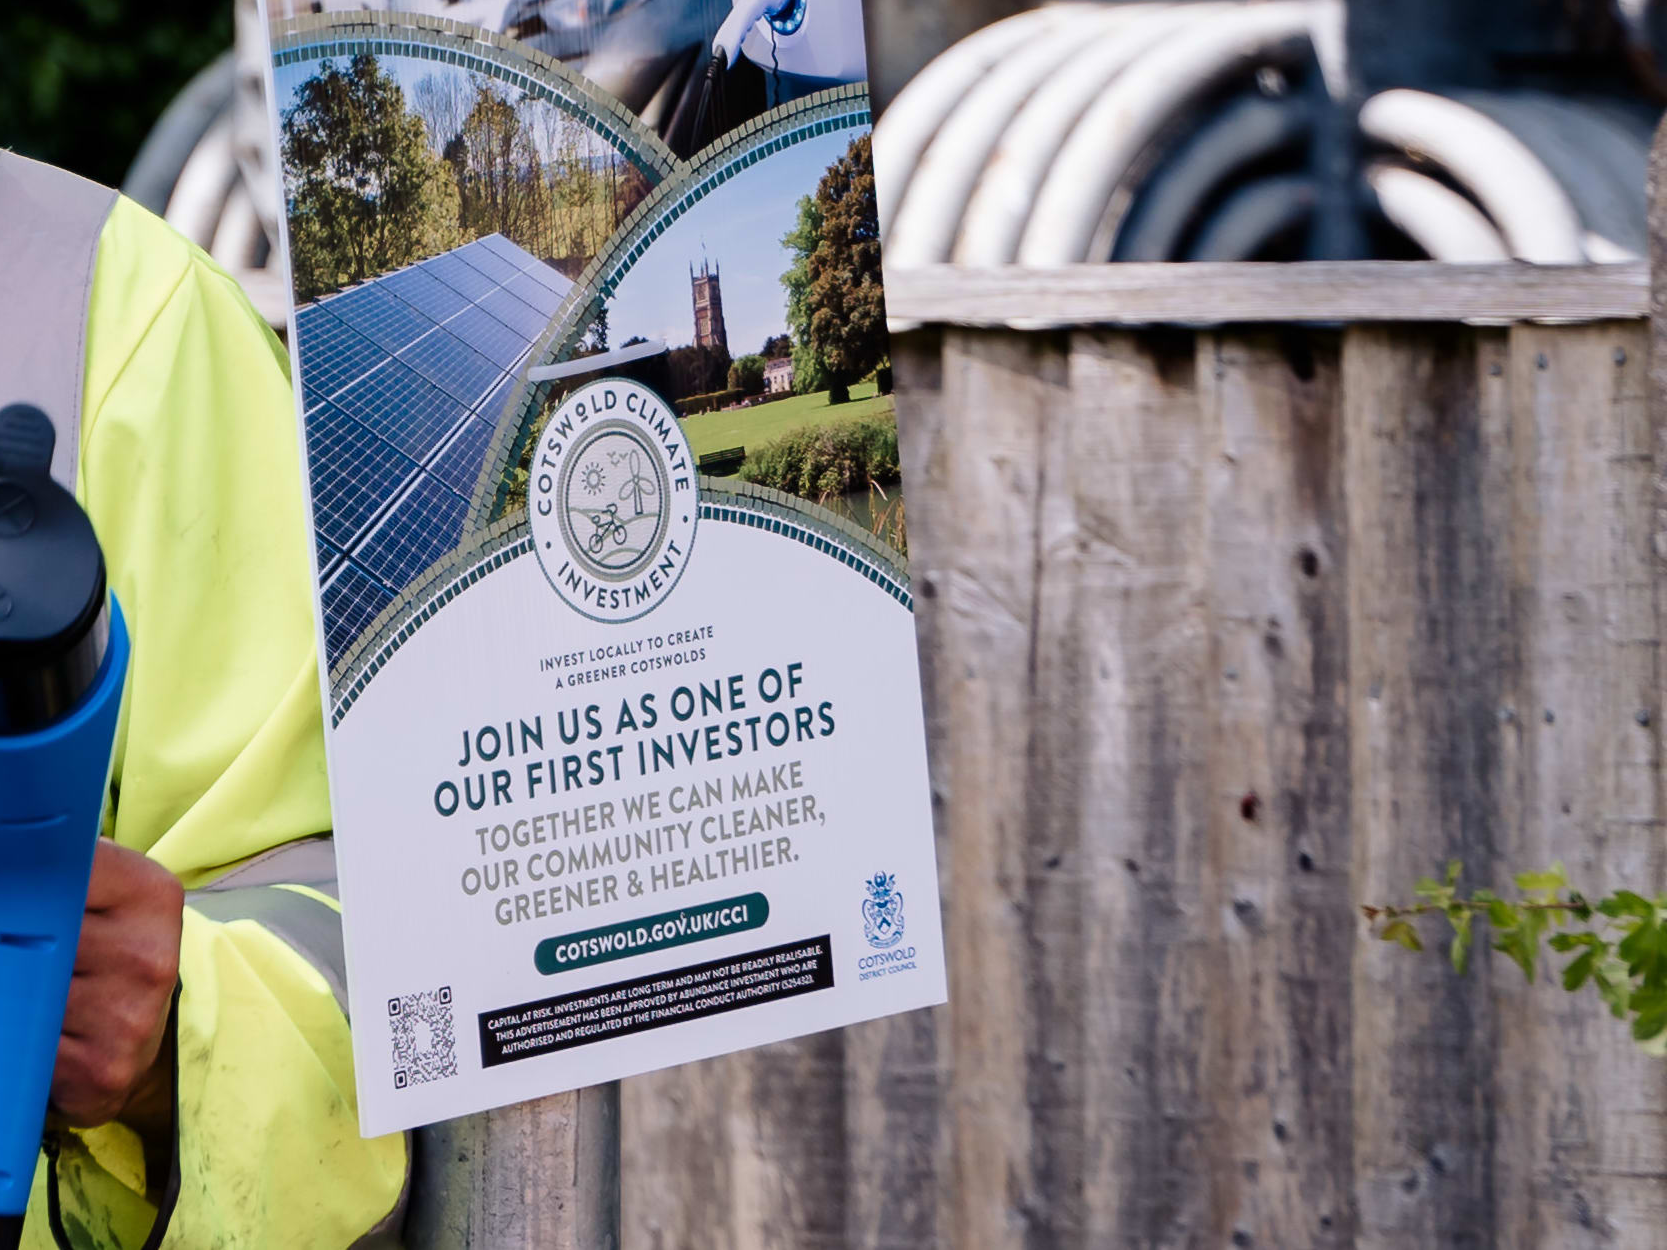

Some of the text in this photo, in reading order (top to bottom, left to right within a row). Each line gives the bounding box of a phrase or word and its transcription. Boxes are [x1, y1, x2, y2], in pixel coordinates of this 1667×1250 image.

[626, 393, 689, 492] CLIMATE
[557, 540, 683, 609] INVESTMENT
[540, 626, 713, 671] INVEST LOCALLY TO CREATE
[556, 648, 705, 689] A GREENER COTSWOLDS
[459, 662, 802, 766] JOIN US AS ONE OF
[434, 701, 835, 817] OUR FIRST INVESTORS
[462, 795, 825, 895] OUR COMMUNITY CLEANER,
[476, 802, 615, 855] TOGETHER
[669, 778, 723, 813] CAN
[732, 760, 803, 801] MAKE
[496, 837, 799, 925] GREENER & HEALTHIER.
[554, 905, 748, 963] COTSWOLD.GOV.UK/CCI
[859, 947, 916, 969] COTSWOLD
[488, 1014, 521, 1029] CAPITAL
[522, 1012, 532, 1022] AT
[555, 994, 610, 1016] INVESTMENTS
[611, 990, 626, 1002] ARE
[628, 985, 651, 998] LONG
[652, 980, 673, 993] TERM
[675, 976, 693, 988] AND
[694, 971, 713, 983] MAY
[714, 966, 729, 978] NOT
[731, 963, 741, 974] BE
[742, 956, 775, 972] READILY
[496, 960, 817, 1042] THIS ADVERTISEMENT HAS BEEN APPROVED BY ABUNDANCE INVESTMENT WHO ARE
[502, 1035, 554, 1054] AUTHORISED
[555, 1029, 573, 1041] AND
[575, 1018, 621, 1037] REGULATED
[623, 1015, 633, 1026] BY
[634, 1011, 650, 1024] THE
[651, 1001, 694, 1018] FINANCIAL
[695, 993, 735, 1009] CONDUCT
[736, 983, 780, 1001] AUTHORITY
